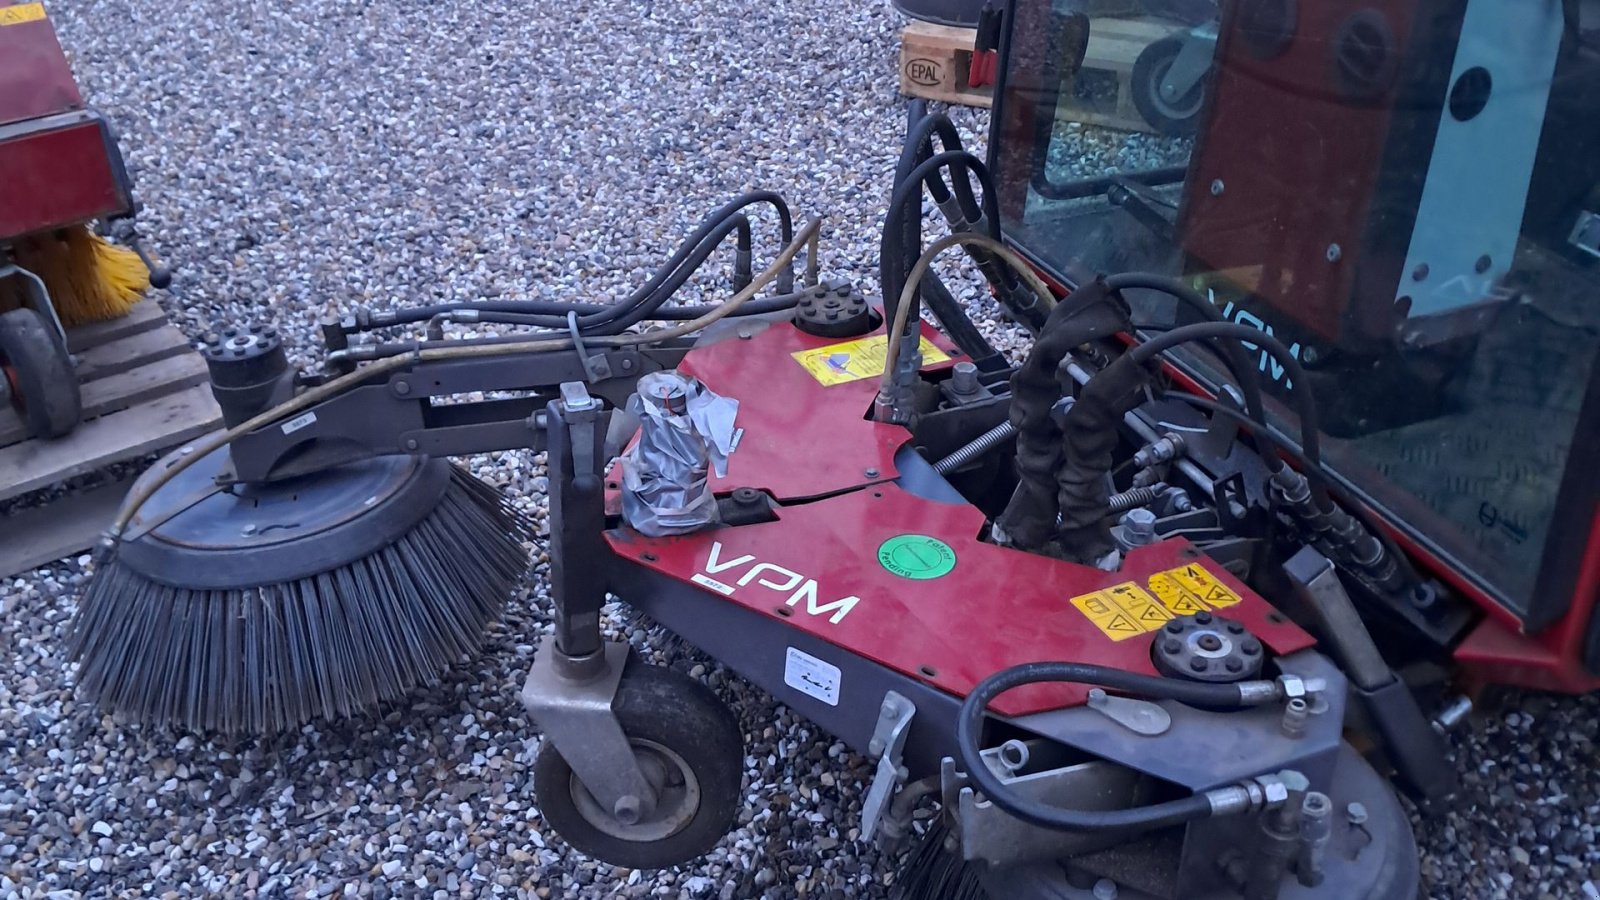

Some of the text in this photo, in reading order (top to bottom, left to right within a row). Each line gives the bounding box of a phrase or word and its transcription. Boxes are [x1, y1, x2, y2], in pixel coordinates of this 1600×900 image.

[911, 63, 938, 81] EPAL
[926, 539, 953, 560] Patent
[881, 551, 912, 577] Pending
[705, 541, 861, 625] VPM
